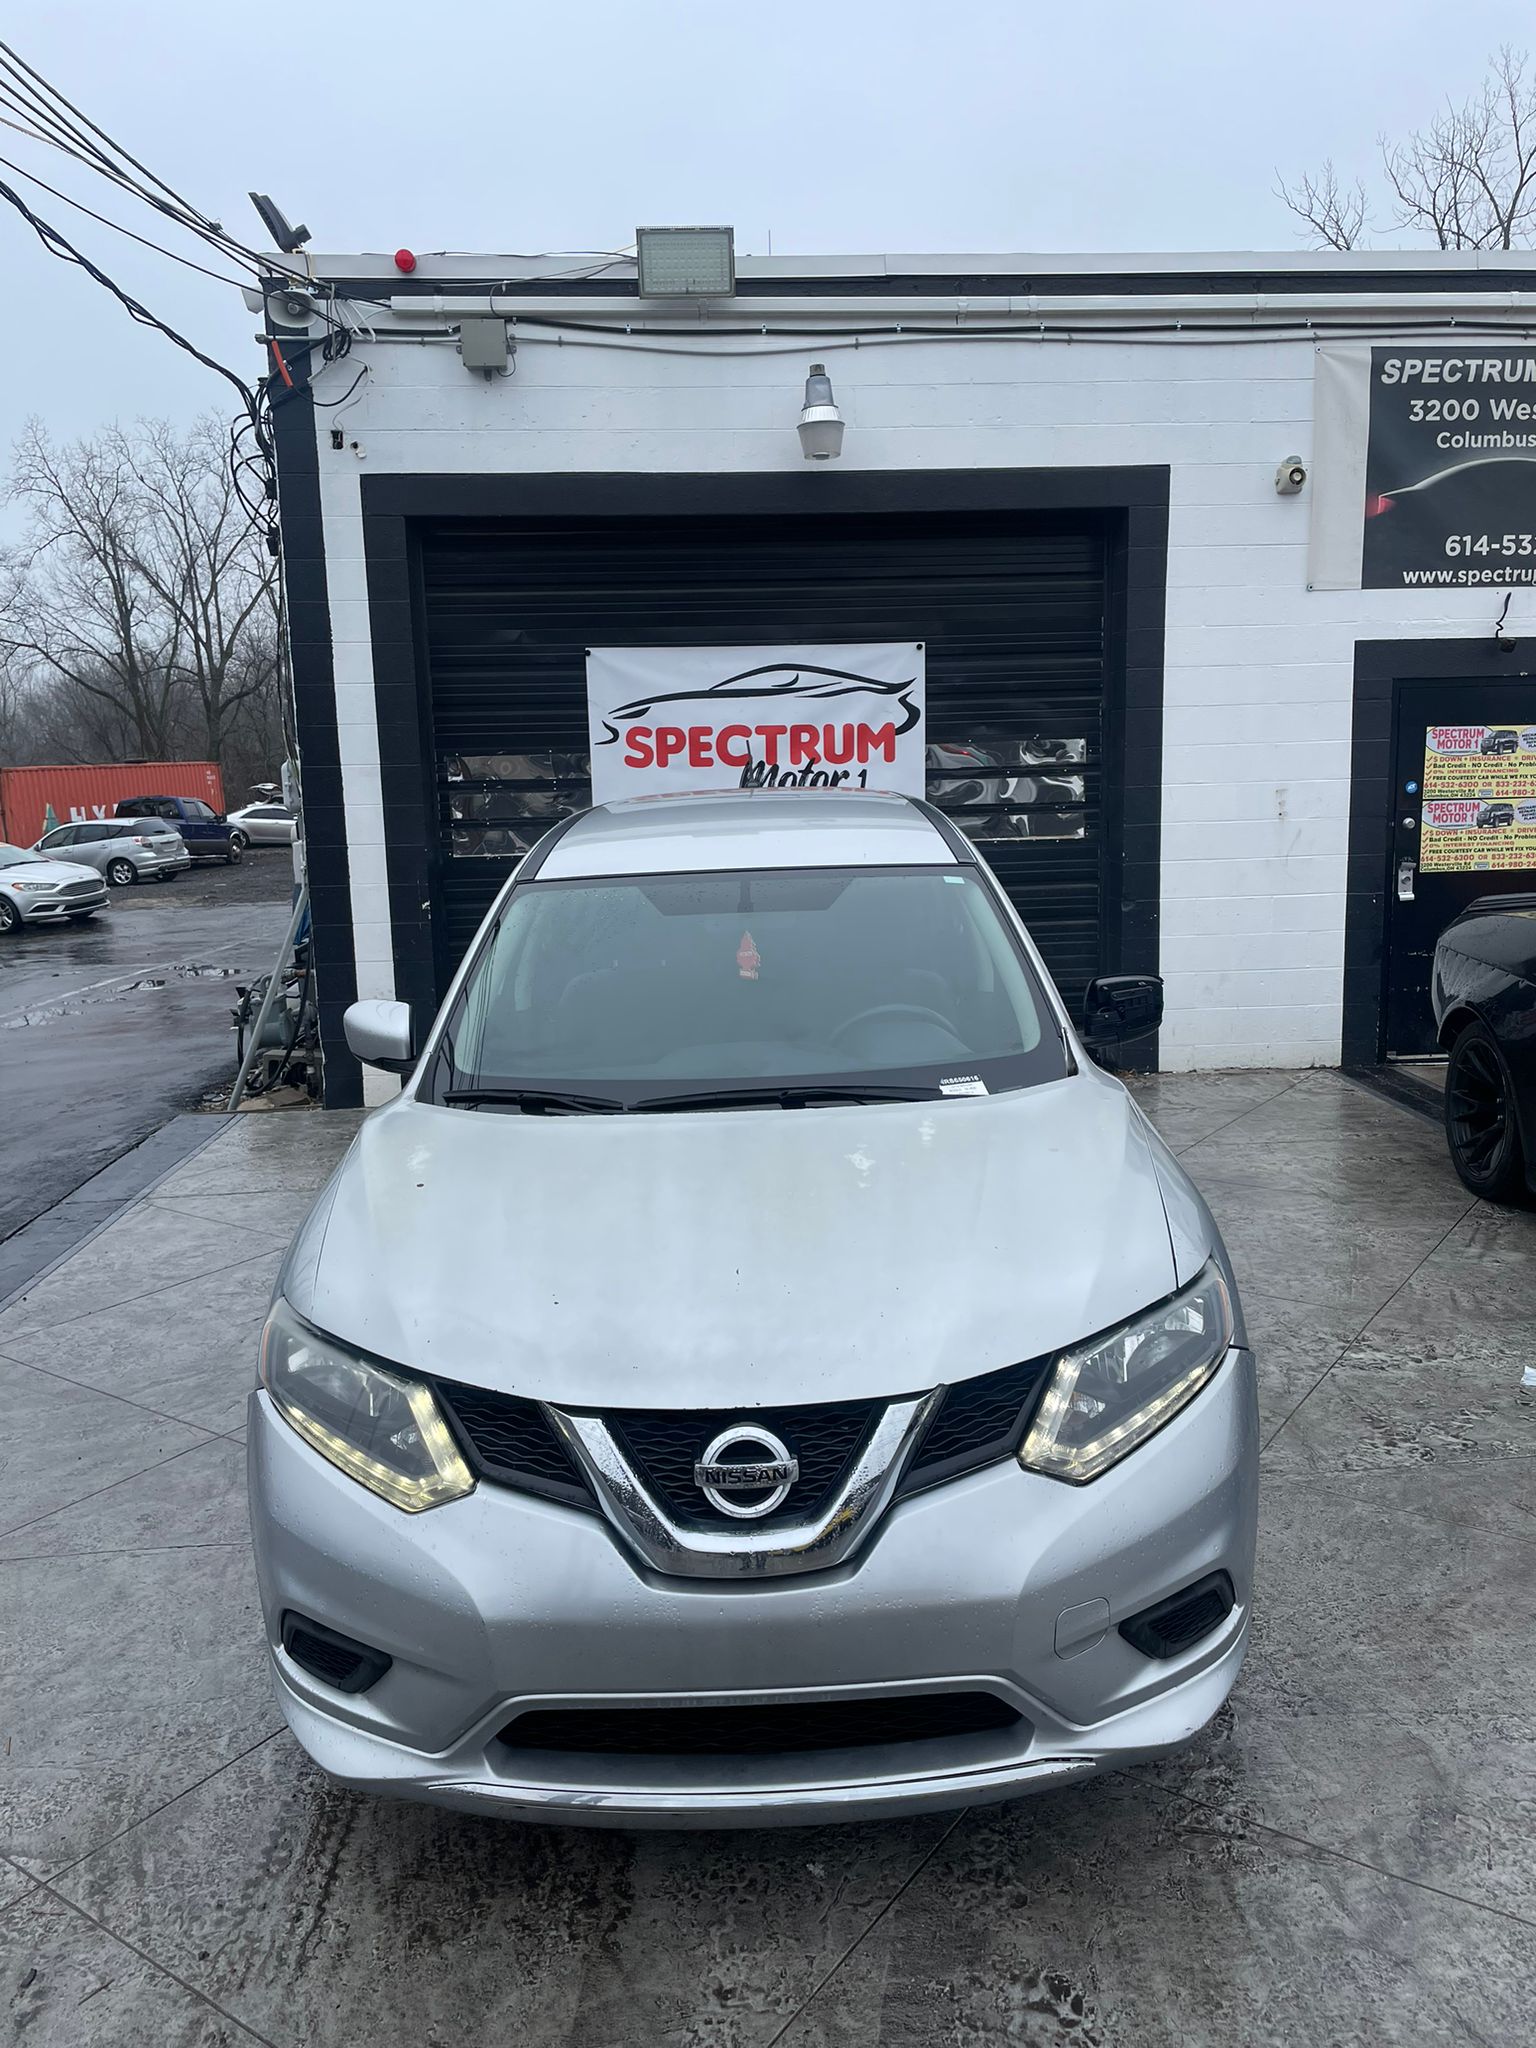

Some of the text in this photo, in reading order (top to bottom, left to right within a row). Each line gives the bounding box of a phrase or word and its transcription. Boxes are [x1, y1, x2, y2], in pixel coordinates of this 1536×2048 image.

[1409, 399, 1480, 421] 3200
[1445, 535, 1536, 556] 614-53
[1432, 728, 1485, 740] SPECTRUM
[624, 722, 896, 768] SPECTRUM
[1437, 739, 1479, 750] MOTOR 1
[1440, 755, 1462, 763] DOWN
[1469, 754, 1511, 762] INSURANCE
[739, 757, 868, 789] Motor 1
[1427, 802, 1480, 813] SPECTRUM
[1433, 813, 1475, 824] MOTOR 1
[705, 1465, 788, 1485] NISSAN
